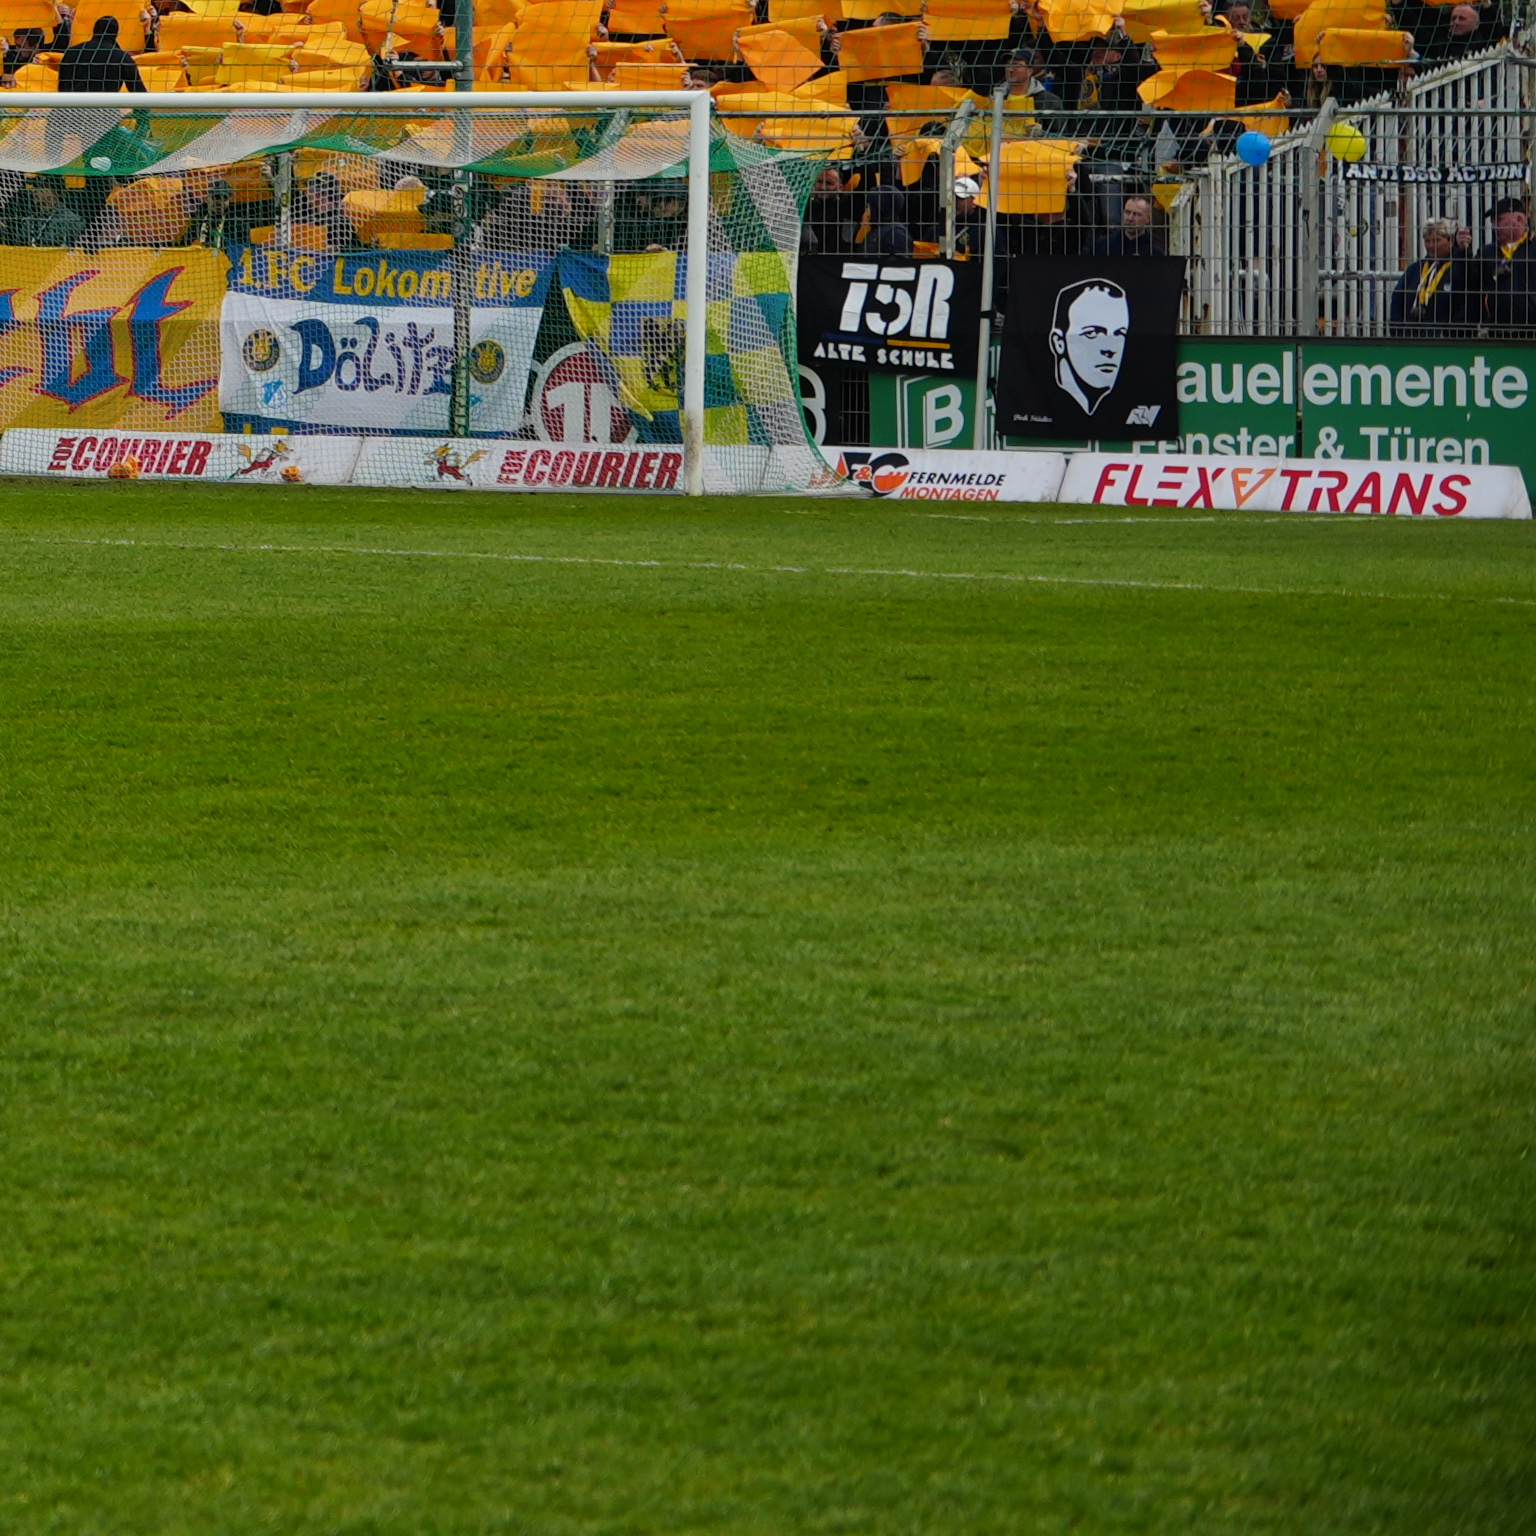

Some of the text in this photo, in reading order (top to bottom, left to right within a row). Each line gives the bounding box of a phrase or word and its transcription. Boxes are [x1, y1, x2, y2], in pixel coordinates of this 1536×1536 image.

[1346, 163, 1399, 180] ANTI
[814, 342, 954, 369] ALTE SCHULE
[1176, 350, 1528, 408] auelemente
[72, 436, 213, 475] COURIER
[1359, 426, 1490, 465] Türen
[523, 449, 683, 488] COURIER
[908, 471, 1006, 486] FERNMELDE
[899, 486, 1001, 501] MONTAGEN
[1093, 463, 1471, 516] FLEX TRANS
